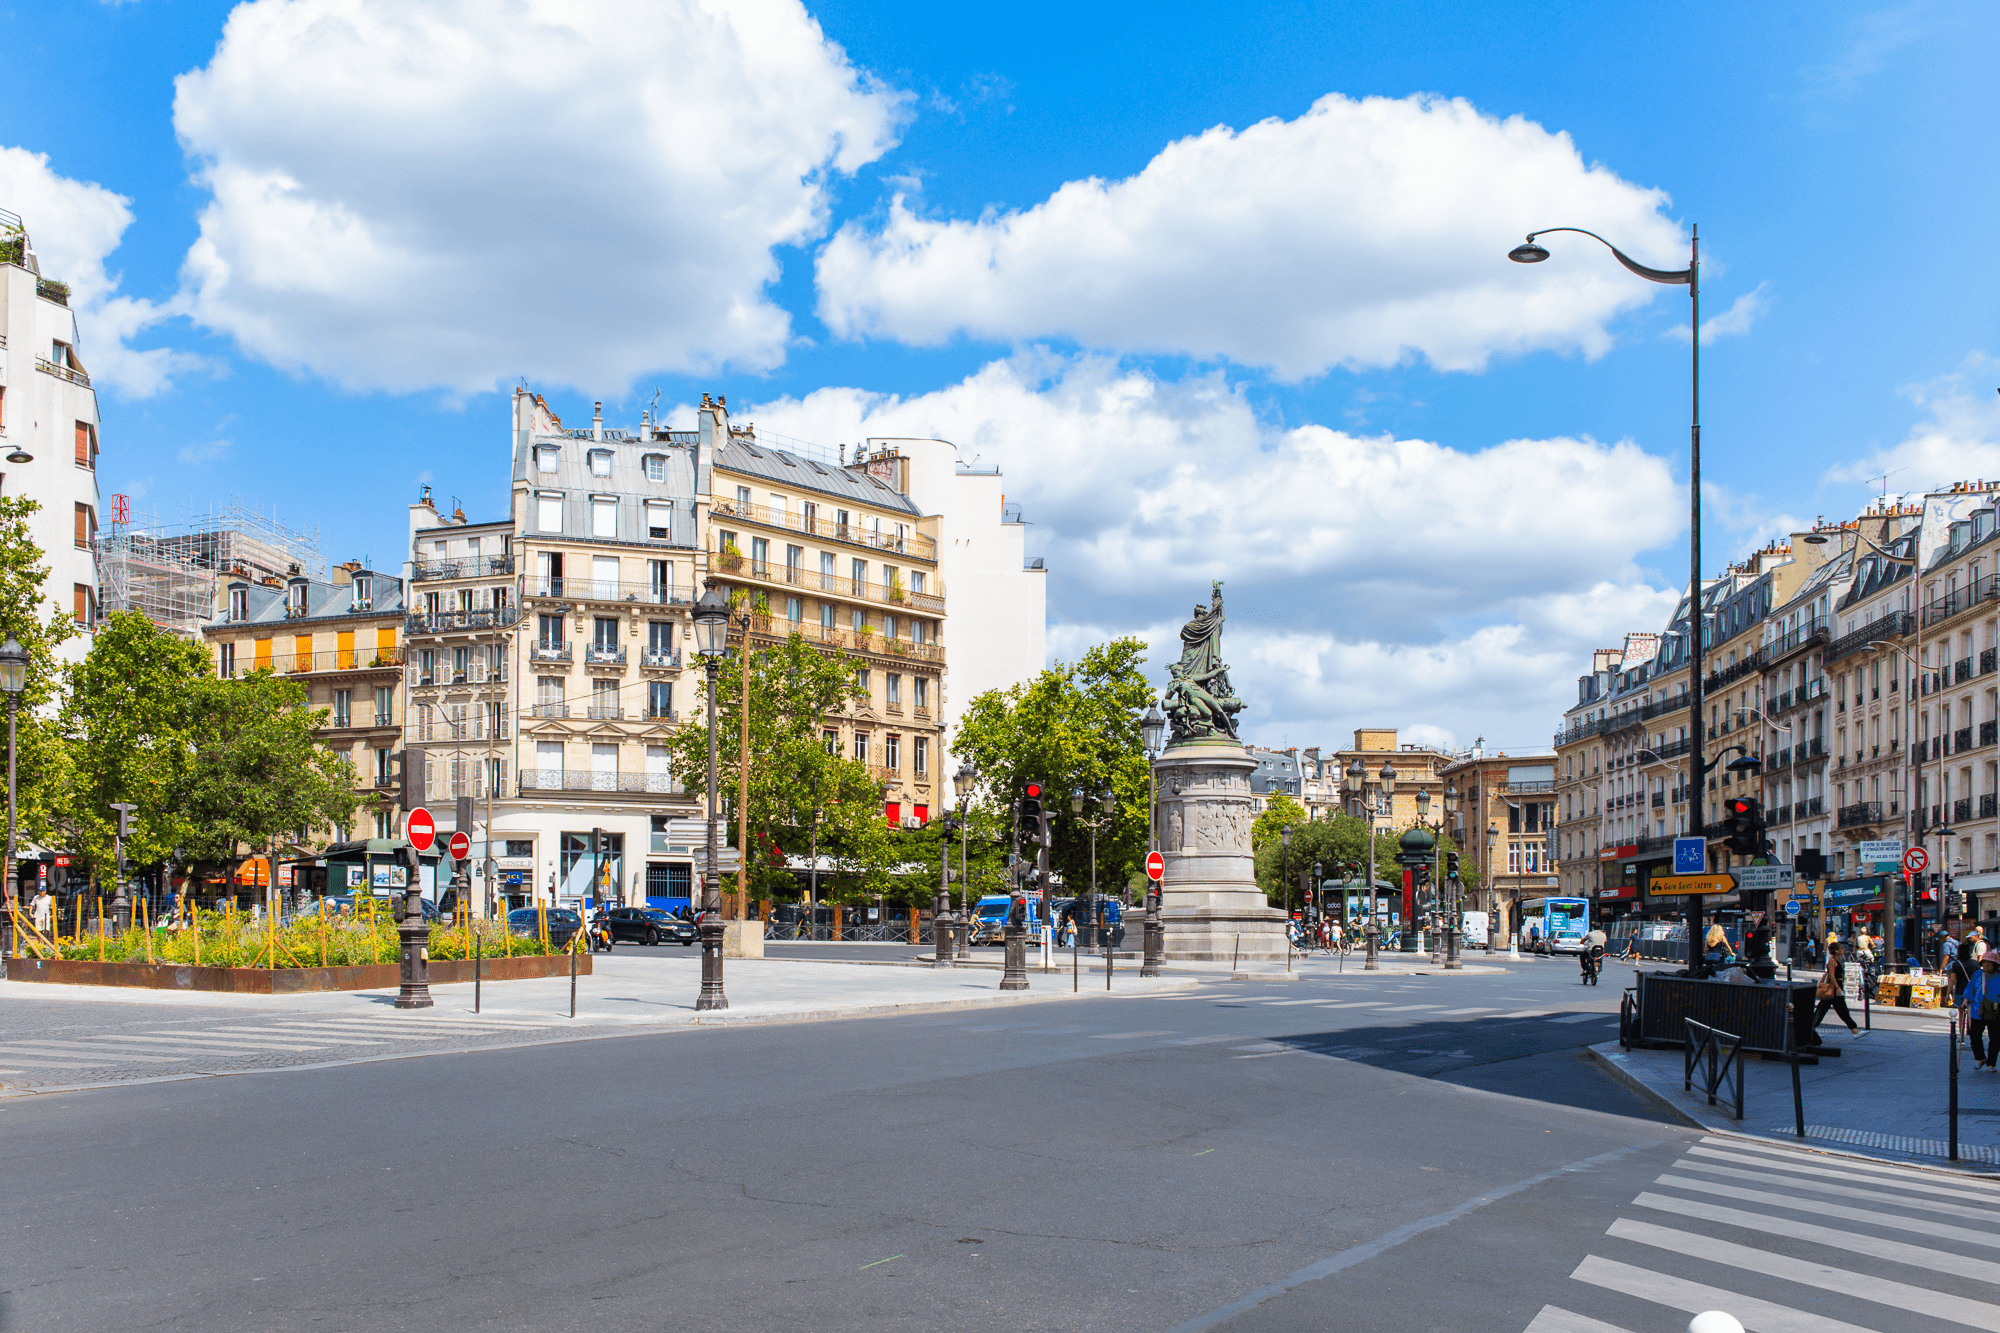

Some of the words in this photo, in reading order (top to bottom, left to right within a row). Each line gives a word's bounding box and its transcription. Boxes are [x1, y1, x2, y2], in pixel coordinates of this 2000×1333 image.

[1663, 882, 1677, 890] Gare
[1678, 881, 1692, 890] Saint
[1694, 881, 1712, 889] Lazare
